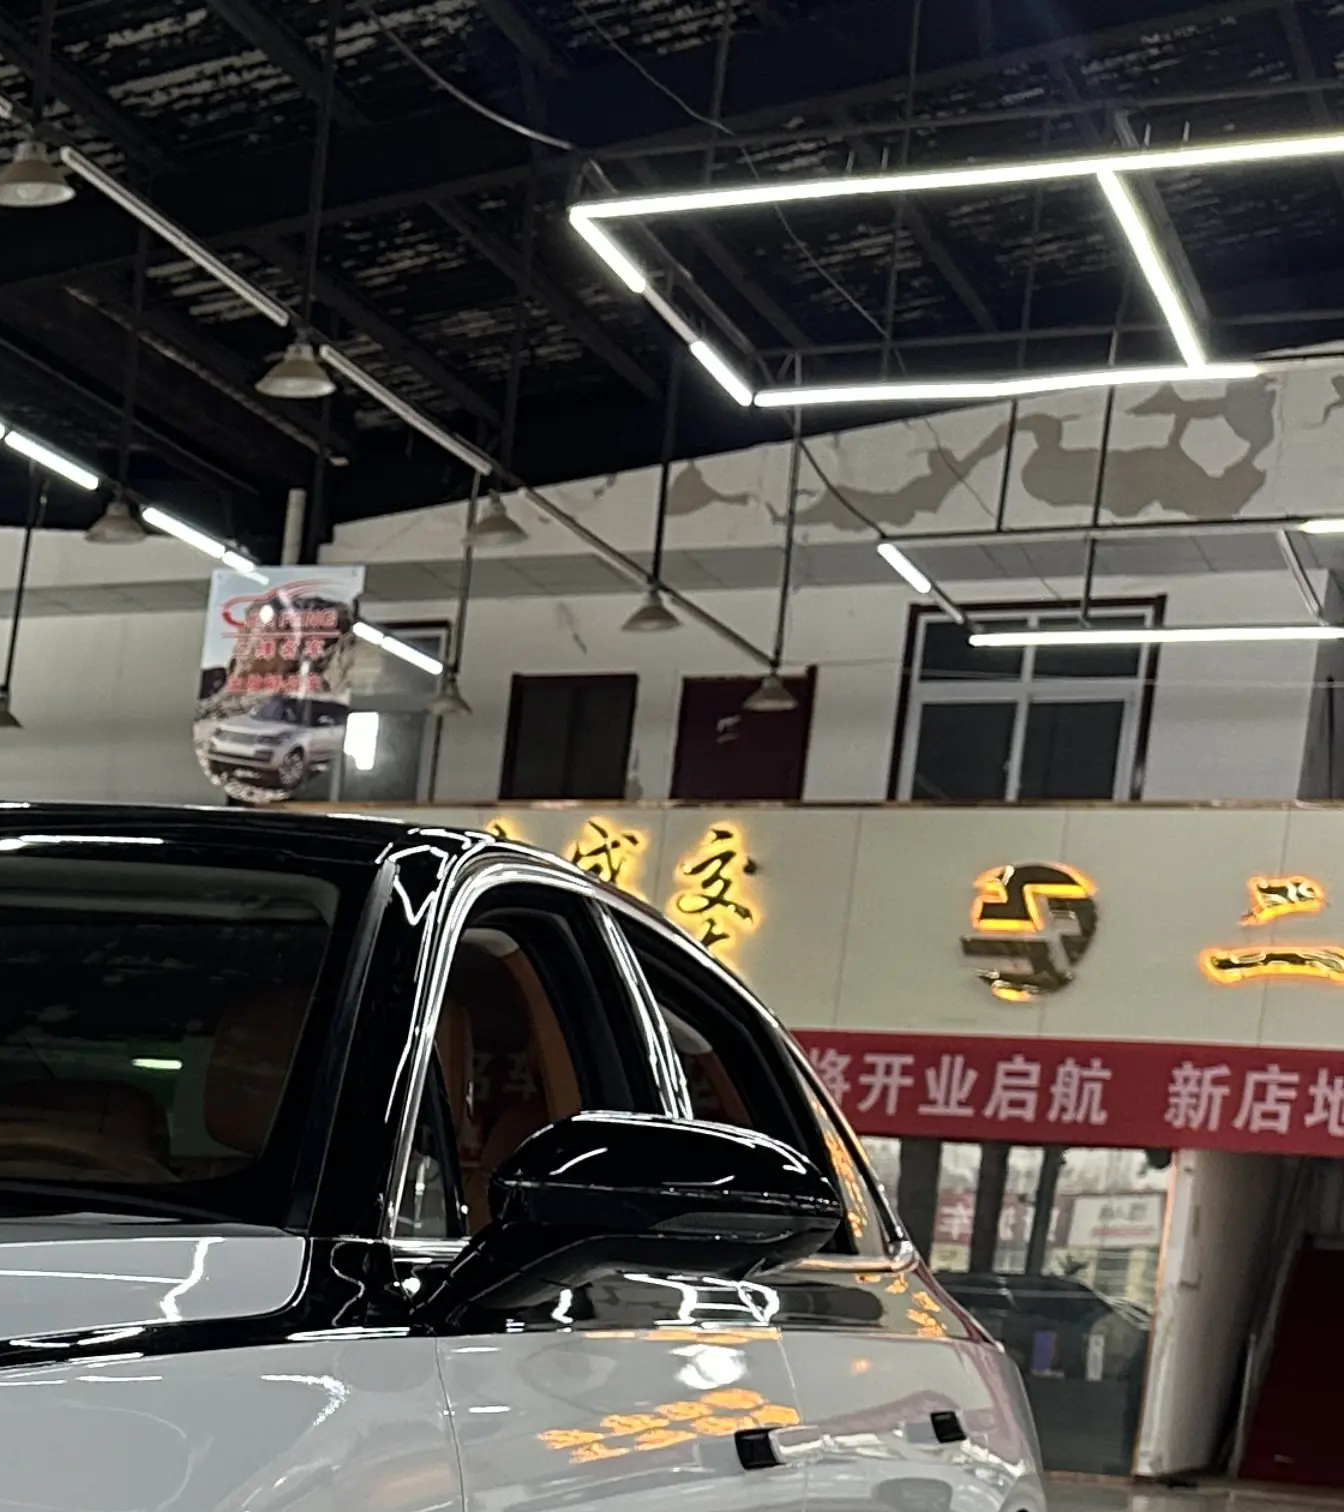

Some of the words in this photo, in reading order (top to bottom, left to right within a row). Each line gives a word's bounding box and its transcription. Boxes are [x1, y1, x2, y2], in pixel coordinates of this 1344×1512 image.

[809, 1047, 1112, 1126] 将开业启航
